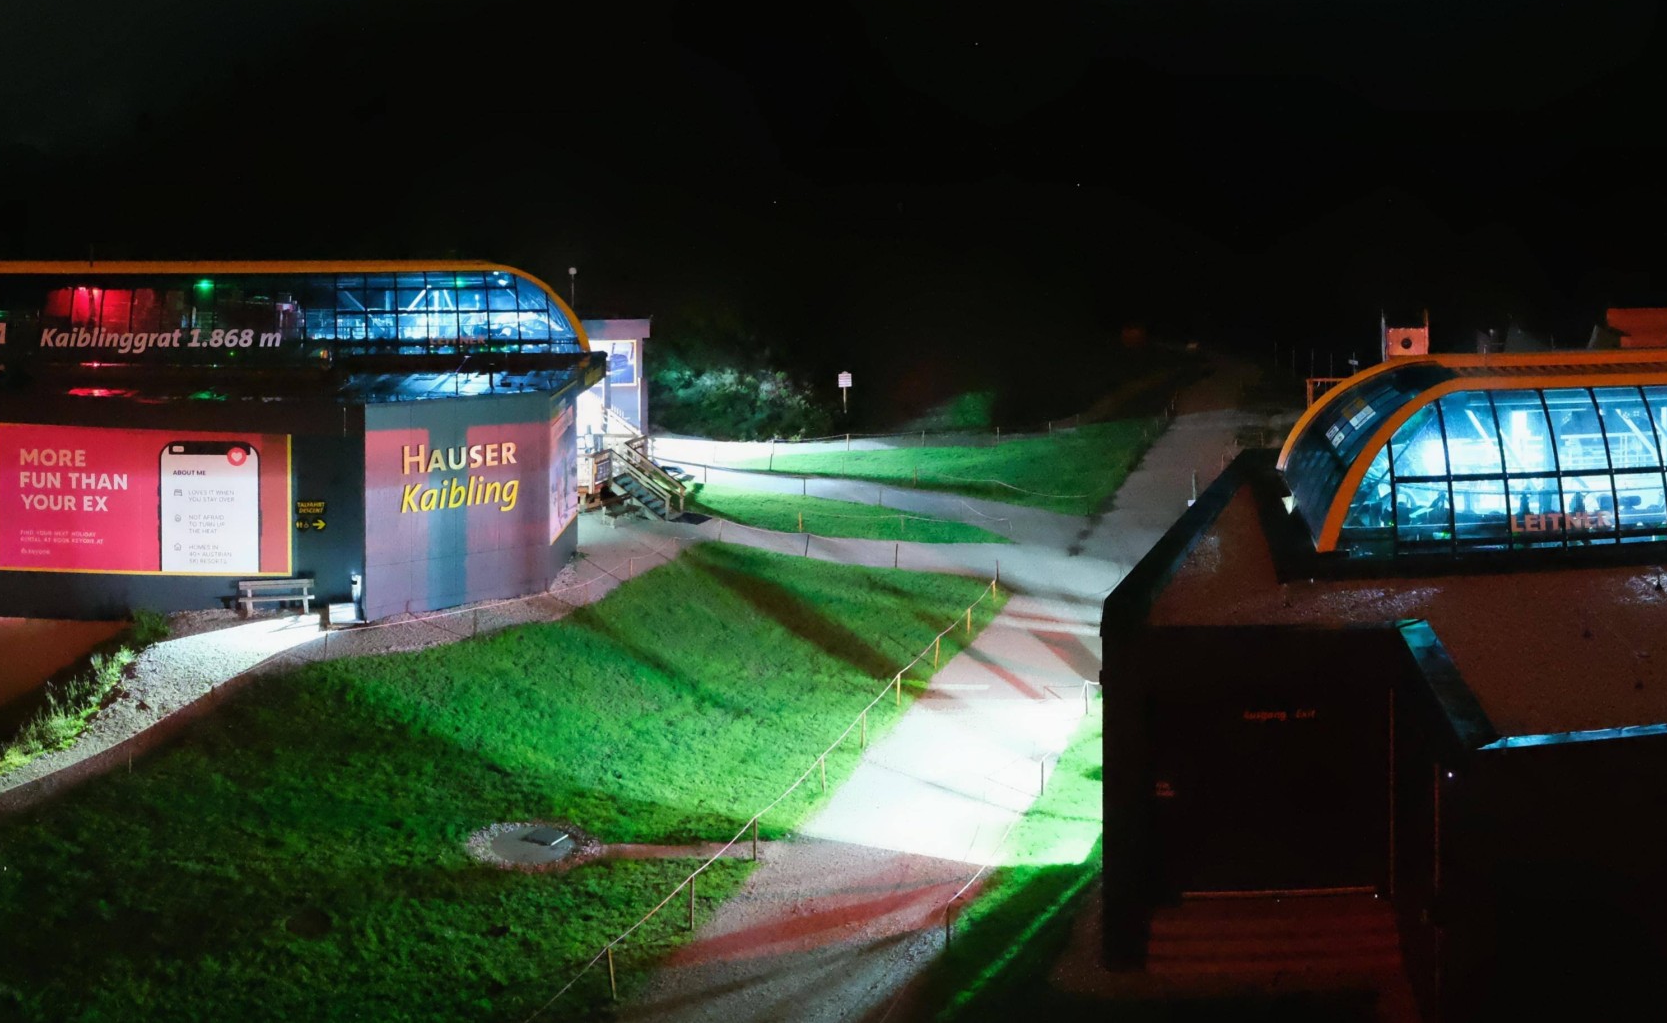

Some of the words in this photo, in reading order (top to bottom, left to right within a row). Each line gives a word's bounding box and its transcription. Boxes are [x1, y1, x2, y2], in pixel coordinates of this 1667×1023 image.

[40, 328, 181, 354] Kaiblinggrat
[187, 328, 254, 348] 1.868
[259, 333, 282, 348] m
[429, 336, 487, 345] LEITNER
[20, 448, 86, 467] MORE
[403, 442, 518, 475] HAUSER
[20, 472, 61, 488] FUN
[68, 473, 128, 490] THAN
[21, 494, 76, 511] YOUR
[83, 496, 108, 512] EX
[401, 476, 519, 513] Kaibling
[1511, 511, 1613, 532] LEITNER
